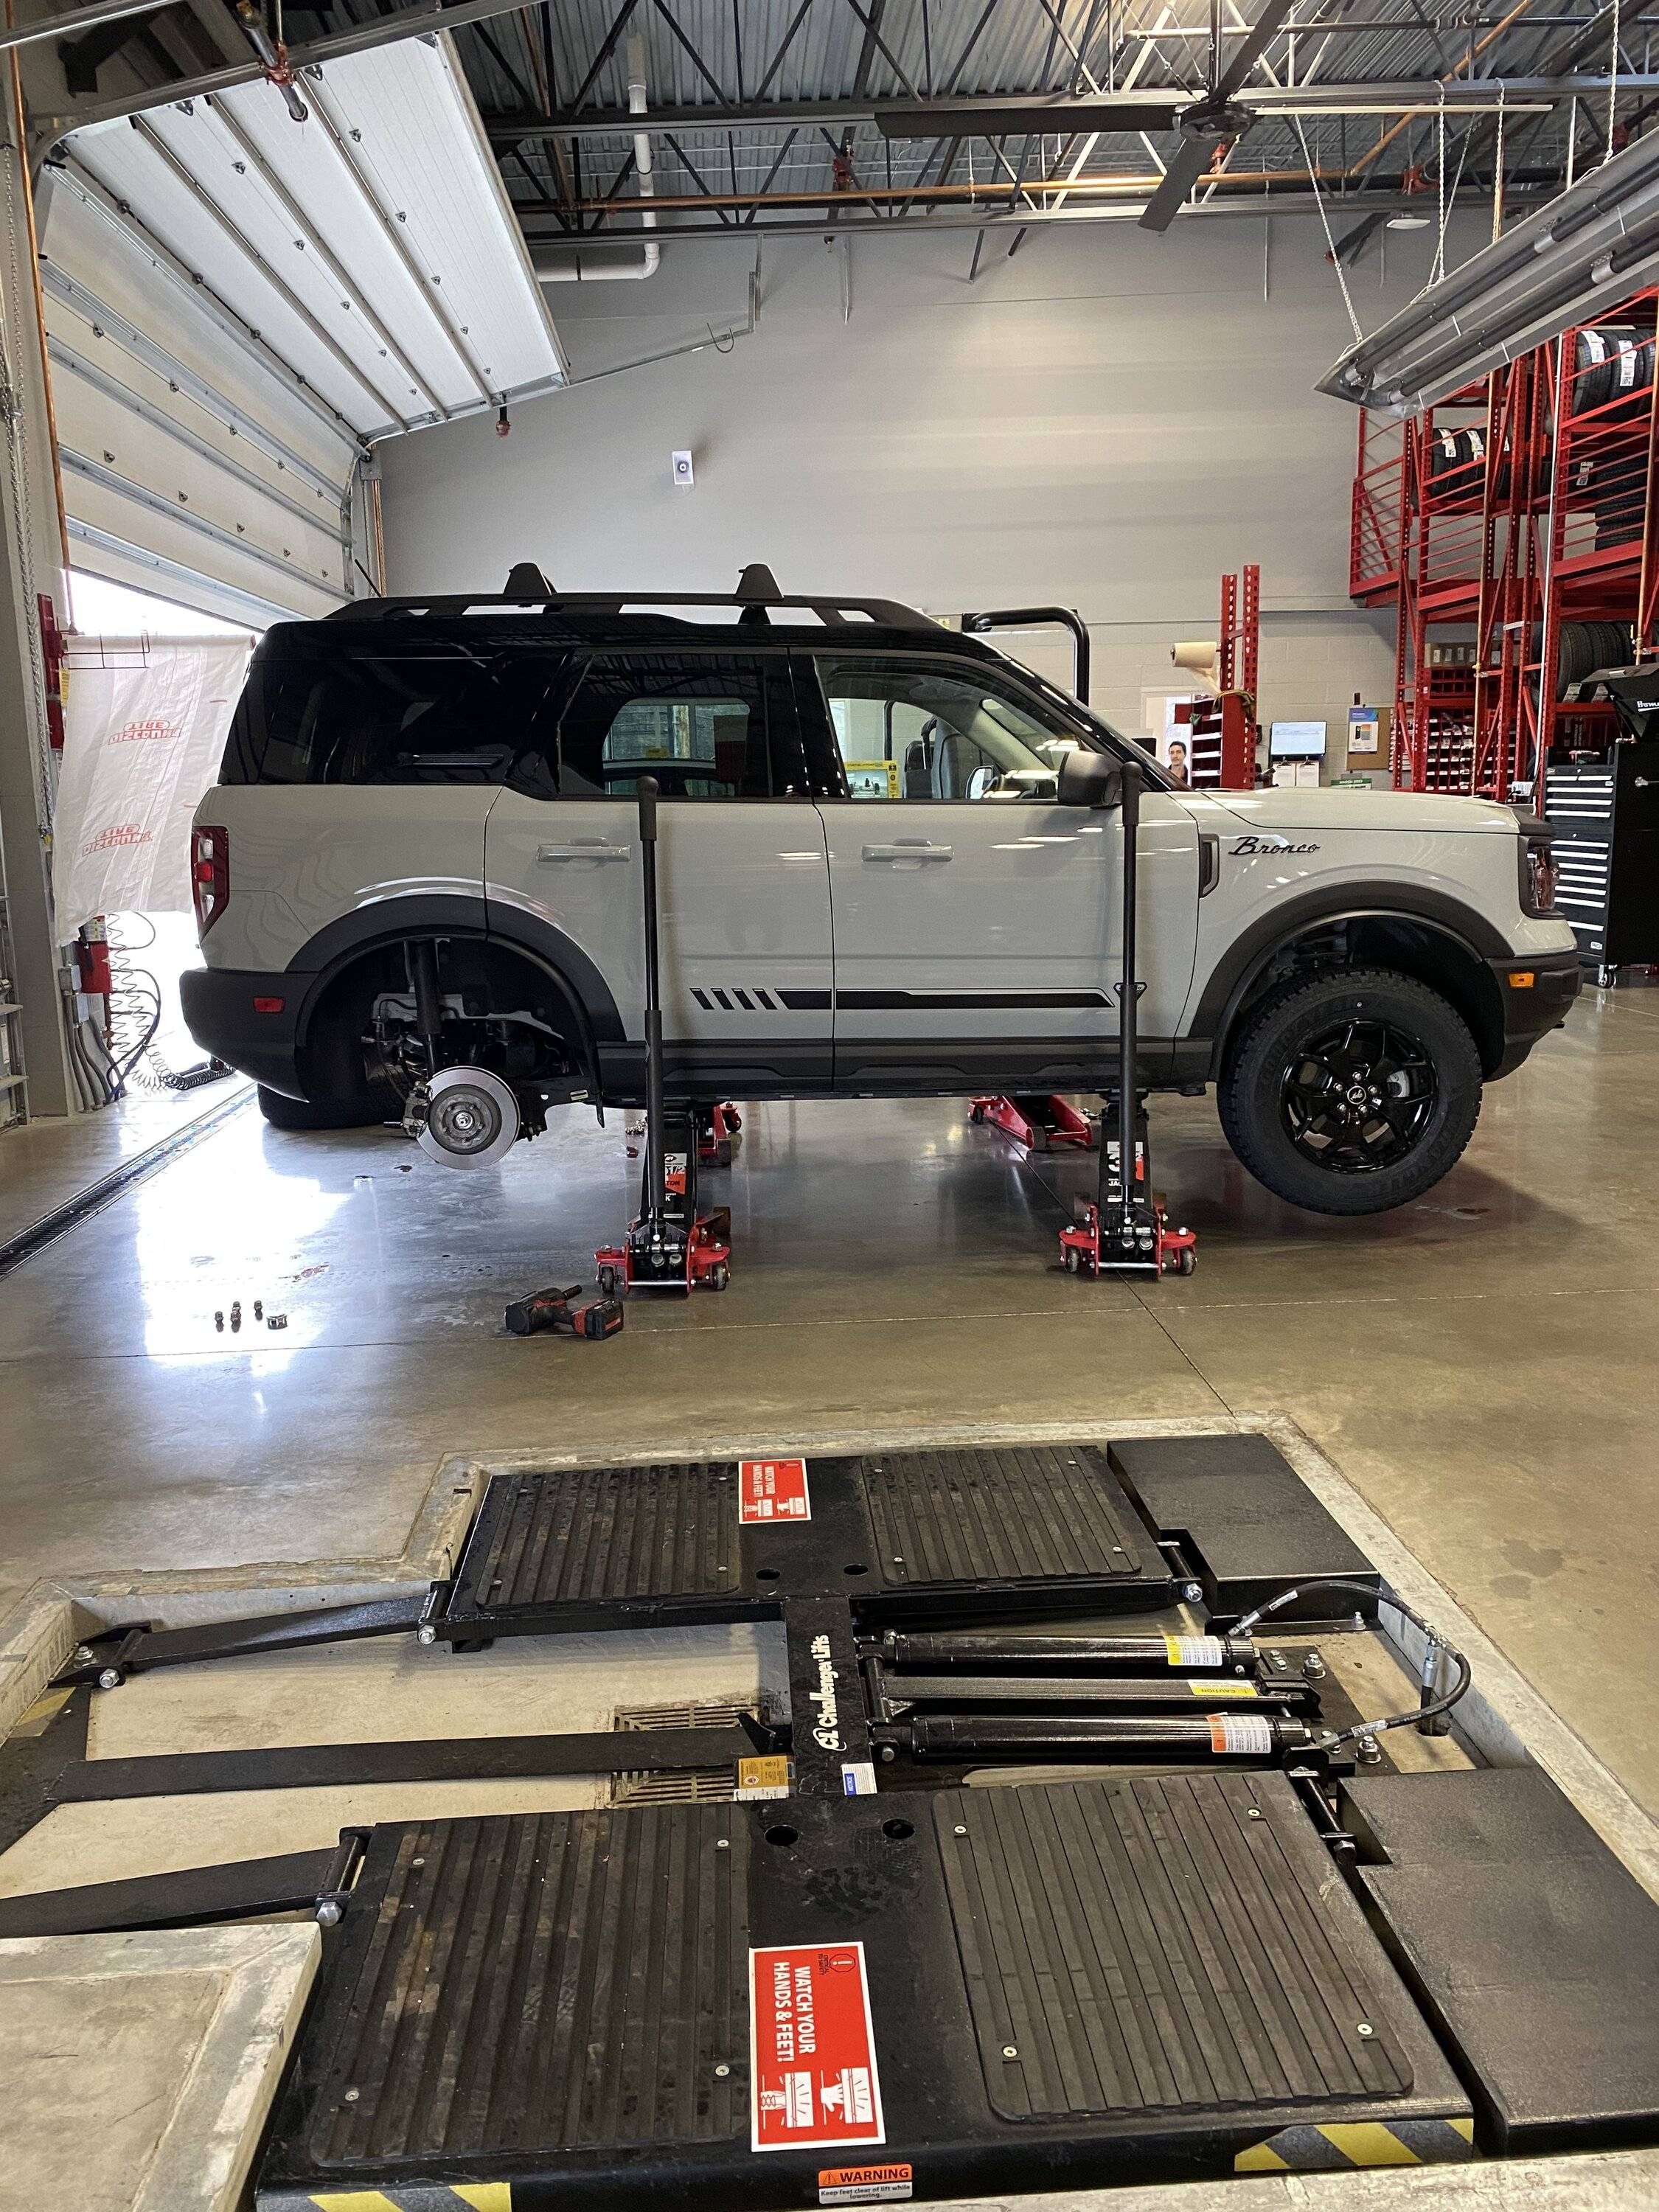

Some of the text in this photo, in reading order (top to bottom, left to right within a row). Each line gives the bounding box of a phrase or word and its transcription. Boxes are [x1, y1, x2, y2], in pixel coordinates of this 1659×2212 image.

[1228, 837, 1321, 855] Bronco
[811, 1635, 832, 1659] Lifts
[810, 1660, 839, 1728] Challenger
[773, 1961, 795, 2062] HANDS & FEET!
[794, 1966, 816, 2054] WATCH YOUR
[840, 2168, 909, 2183] WARNING
